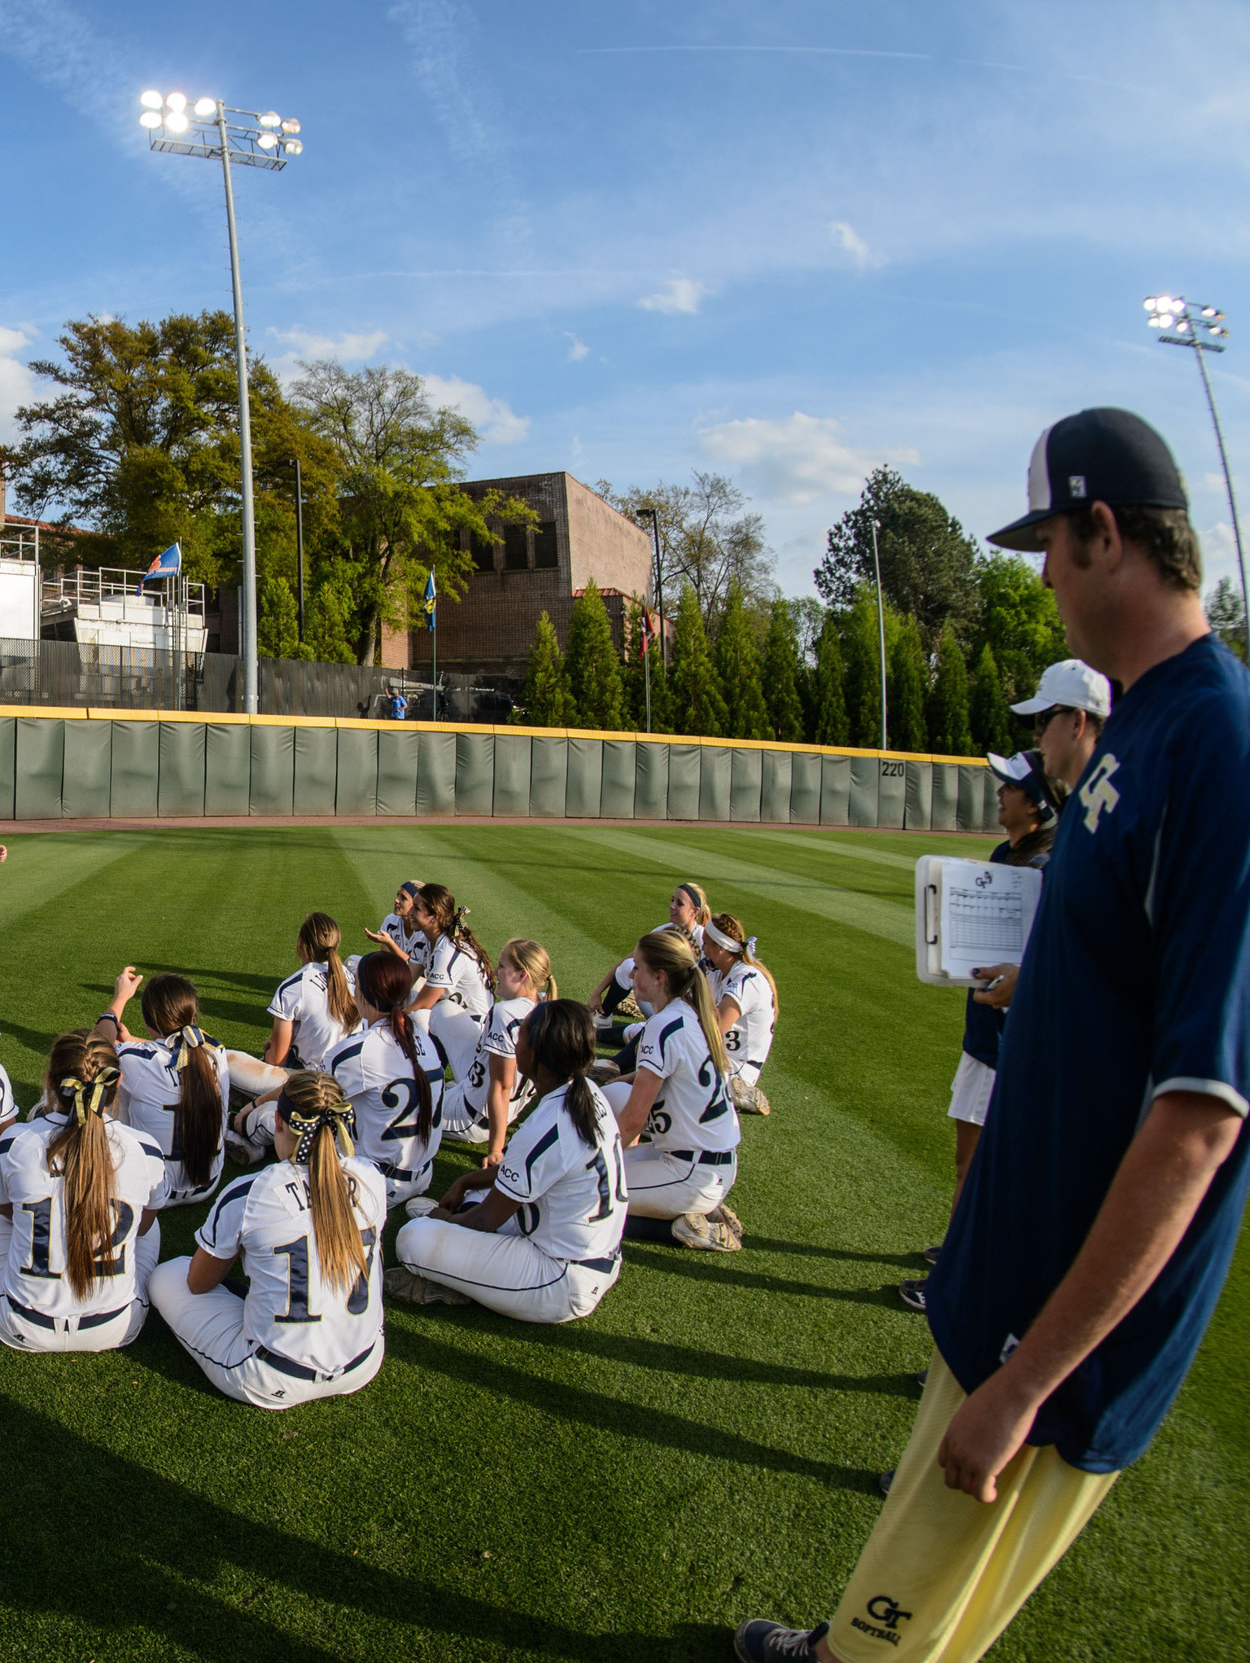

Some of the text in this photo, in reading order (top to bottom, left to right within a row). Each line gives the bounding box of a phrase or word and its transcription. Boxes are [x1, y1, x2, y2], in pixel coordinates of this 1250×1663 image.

[881, 761, 905, 778] 220
[487, 1031, 504, 1043] ACC
[500, 1165, 520, 1182] ACC
[273, 1225, 376, 1324] 17
[866, 1595, 913, 1629] GT
[851, 1617, 902, 1647] SOFTBALL
